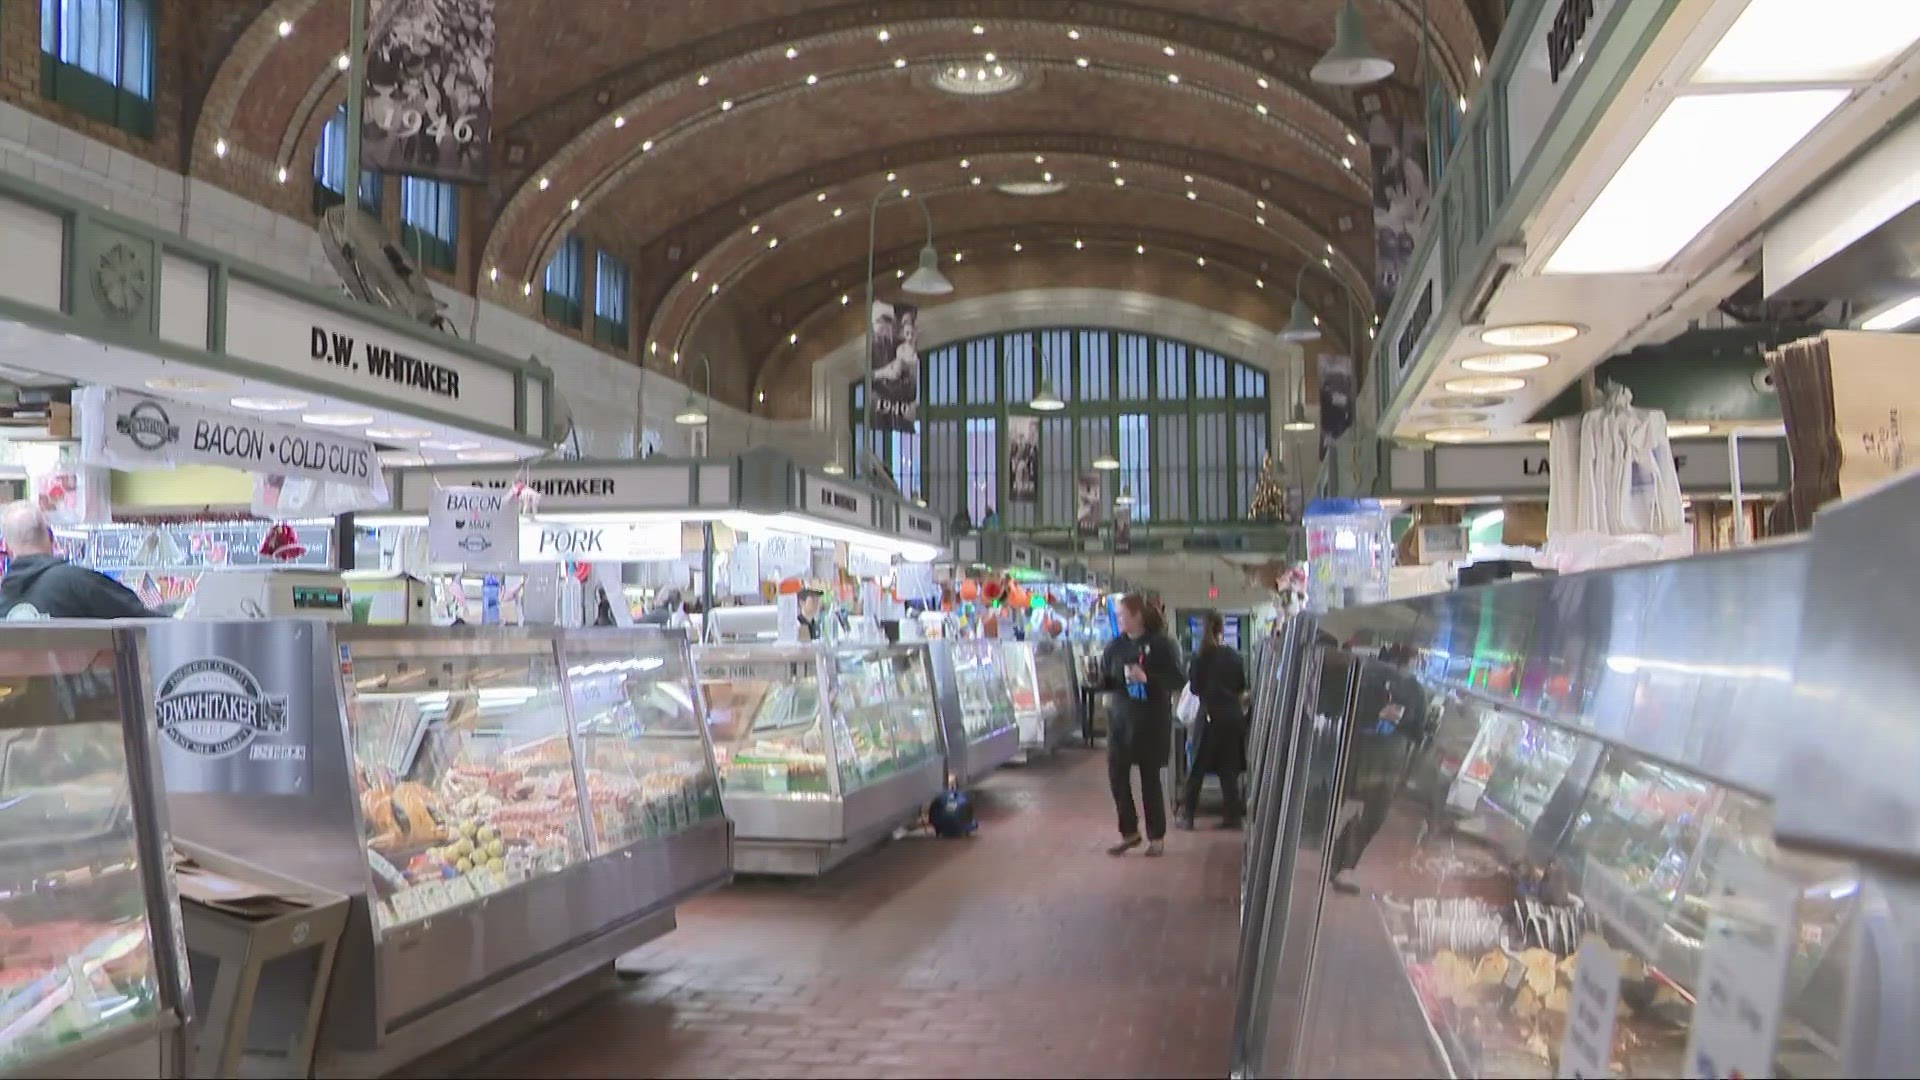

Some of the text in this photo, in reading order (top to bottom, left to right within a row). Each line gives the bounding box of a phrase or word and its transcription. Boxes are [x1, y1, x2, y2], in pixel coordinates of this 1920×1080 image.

[383, 107, 478, 145] 1946
[311, 326, 460, 400] D.W. WHITAKER
[194, 419, 264, 462] BACON
[279, 435, 326, 470] COLD
[329, 444, 368, 478] CUTS
[446, 494, 502, 512] BACON
[531, 479, 615, 496] HITAKER
[539, 528, 604, 554] PORK
